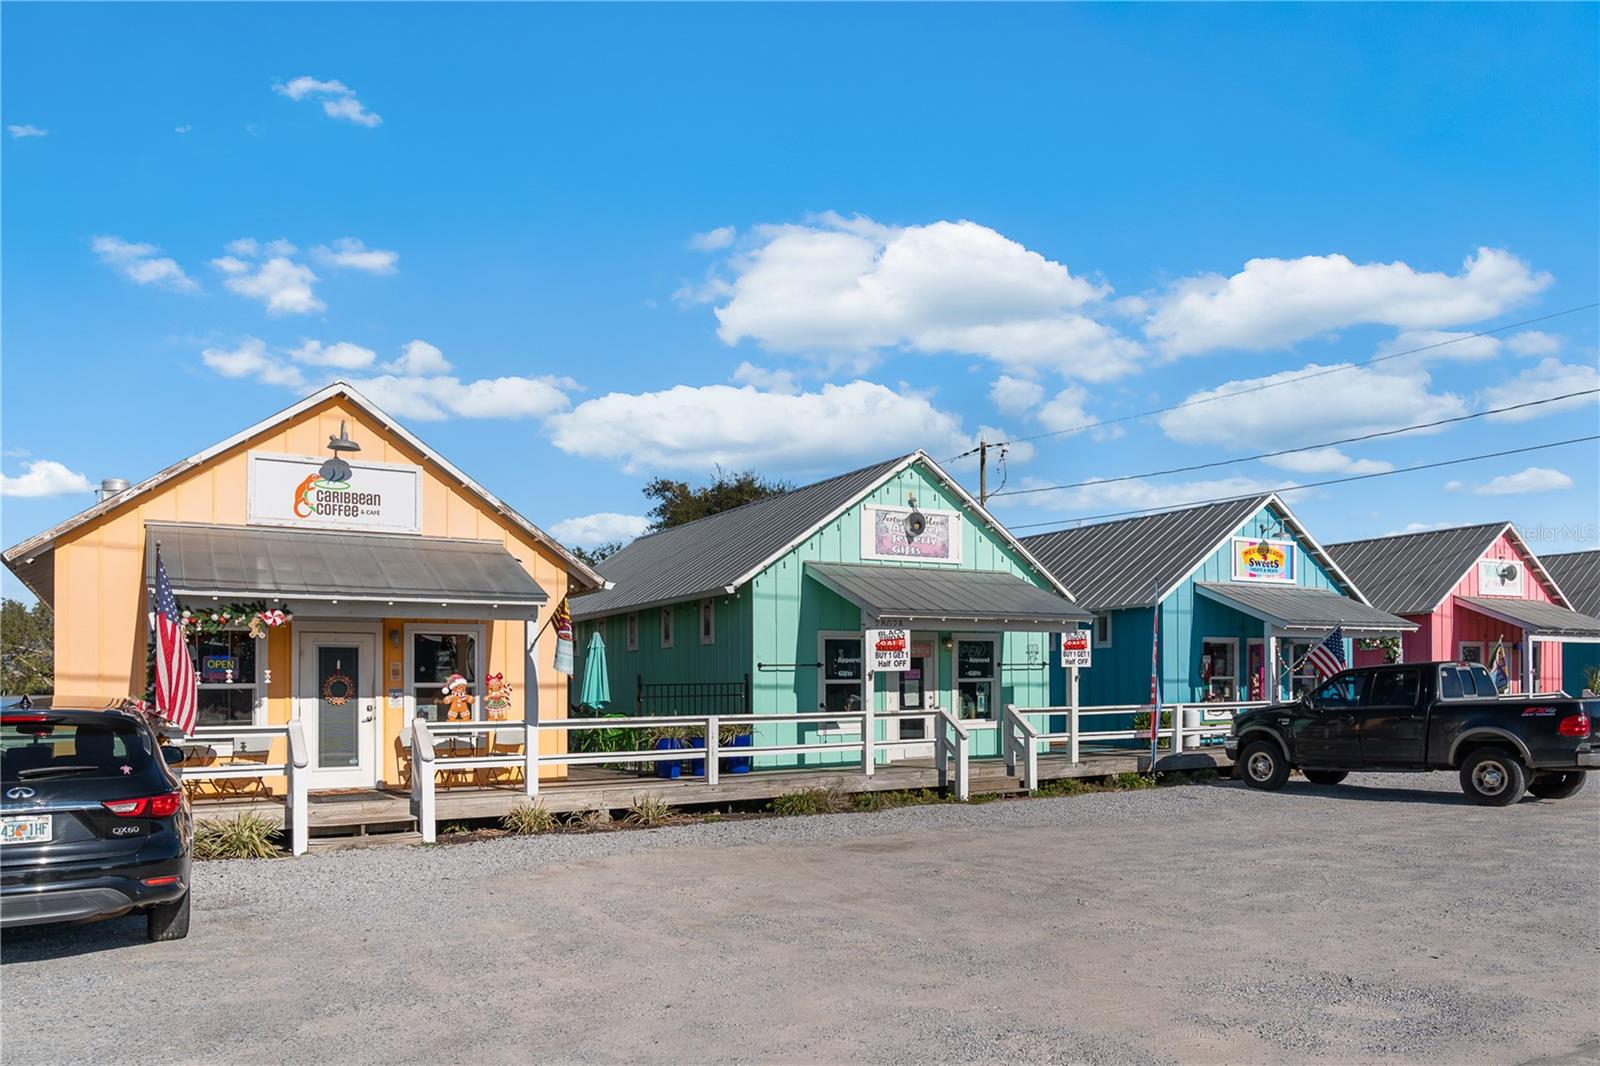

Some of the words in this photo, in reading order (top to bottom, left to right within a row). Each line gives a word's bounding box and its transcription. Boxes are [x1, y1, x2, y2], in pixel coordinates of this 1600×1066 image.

[882, 512, 906, 526] Tortug
[875, 651, 888, 660] BUY
[893, 651, 904, 659] GET
[207, 660, 234, 669] OPEN
[112, 826, 140, 836] QX60
